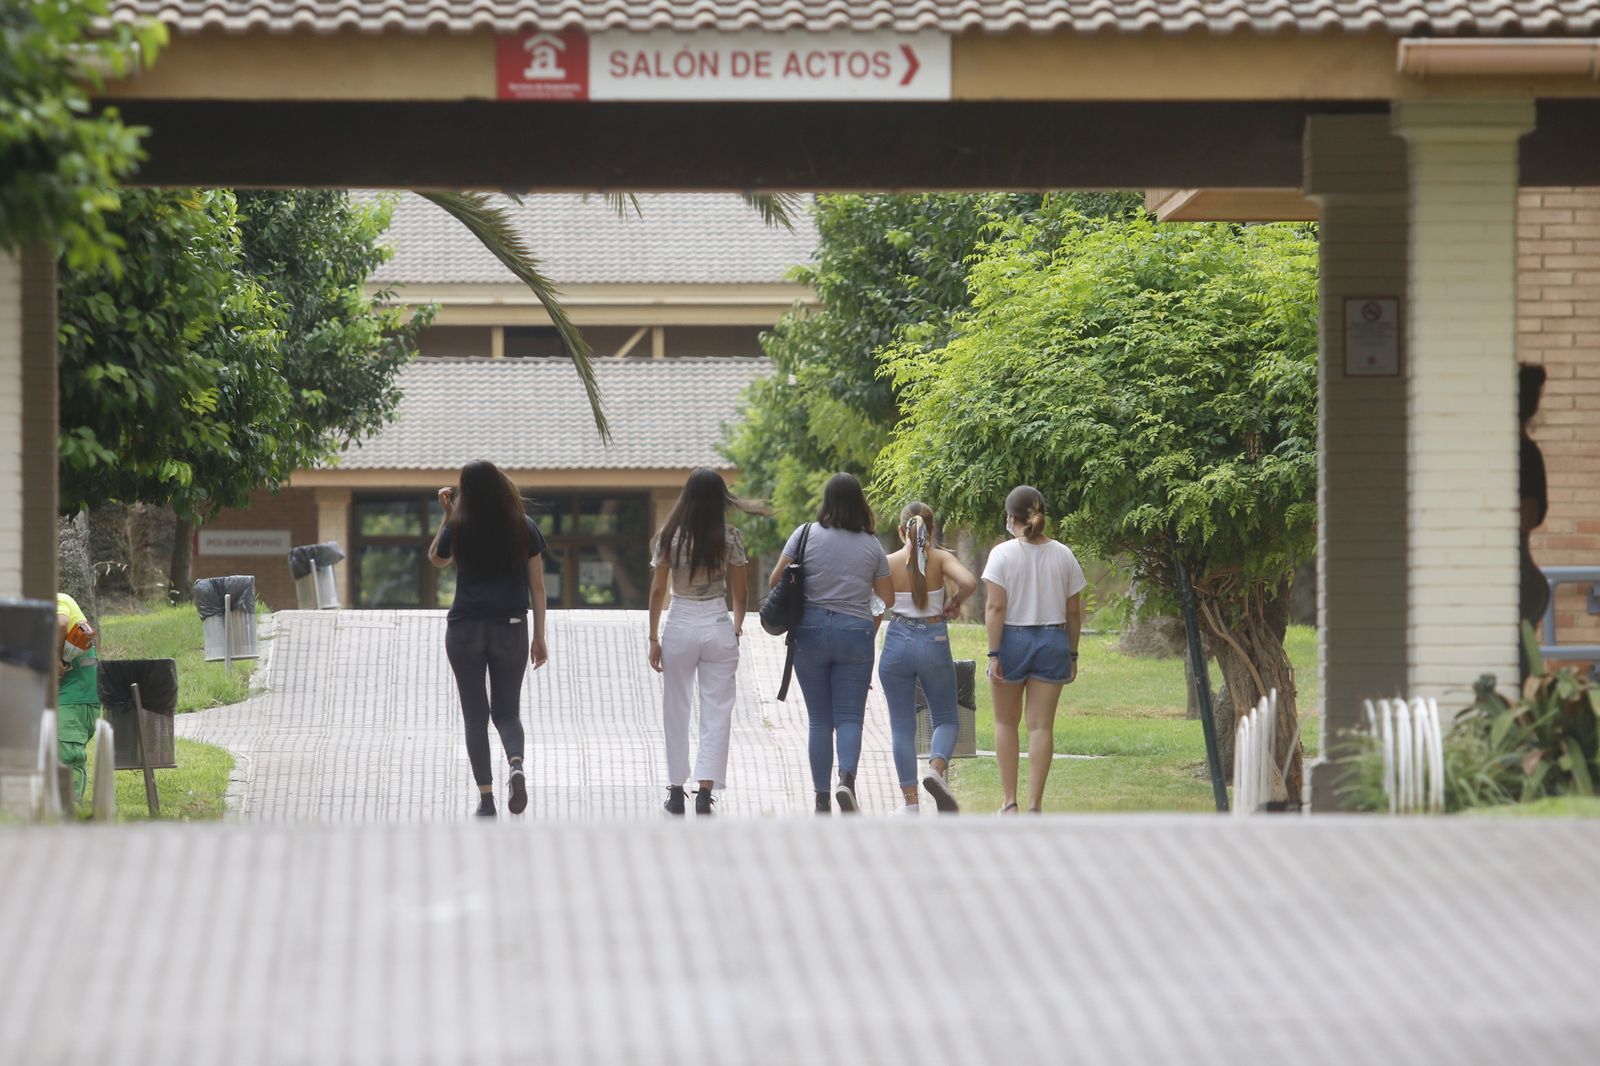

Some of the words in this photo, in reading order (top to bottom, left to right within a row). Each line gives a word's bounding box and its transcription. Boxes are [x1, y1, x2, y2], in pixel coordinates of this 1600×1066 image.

[609, 45, 720, 78] SALÓN
[731, 50, 772, 78] DE
[783, 50, 892, 78] ACTOS
